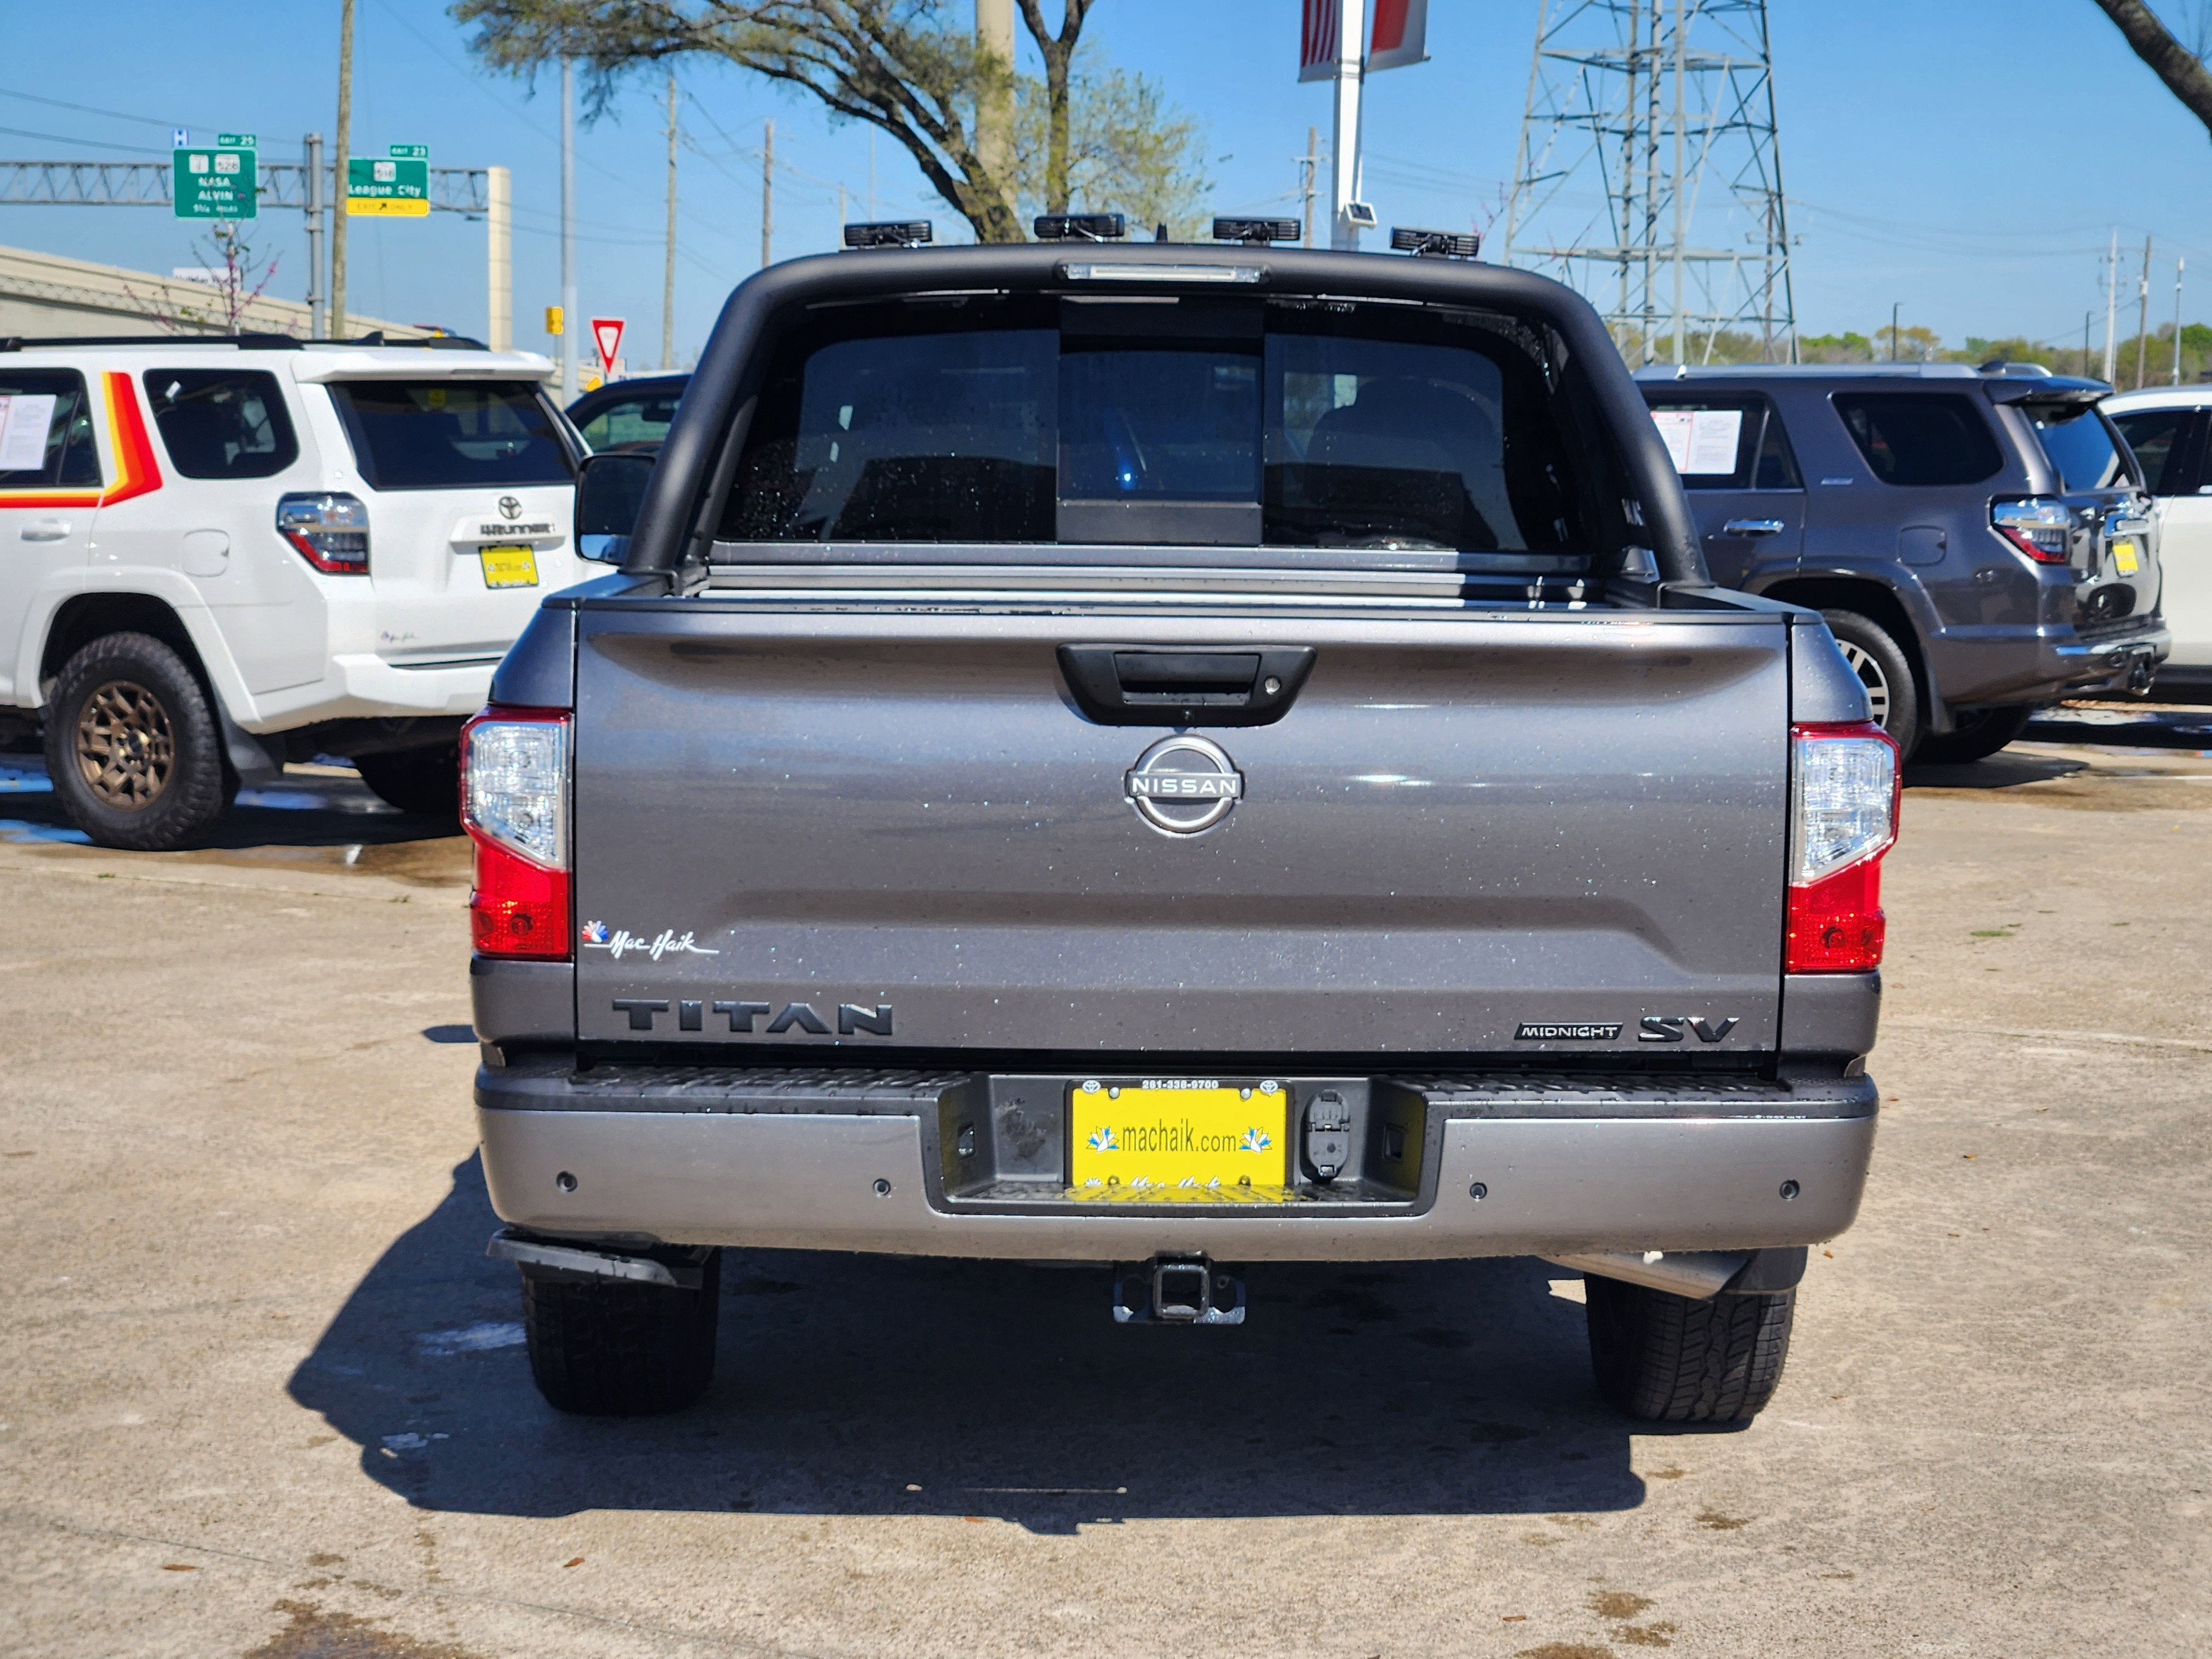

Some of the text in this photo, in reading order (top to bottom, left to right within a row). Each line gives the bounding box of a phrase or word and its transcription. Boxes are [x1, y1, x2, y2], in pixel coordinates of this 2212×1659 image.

[198, 176, 231, 187] NASA
[197, 190, 233, 201] ALVIN
[348, 184, 421, 197] League City
[1132, 777, 1237, 794] NISSAN
[613, 998, 893, 1036] TITAN
[1521, 1016, 1740, 1042] MIDNIGHT SV
[1142, 1079, 1219, 1089] 281-338-9700
[1122, 1119, 1237, 1152] machaik.com
